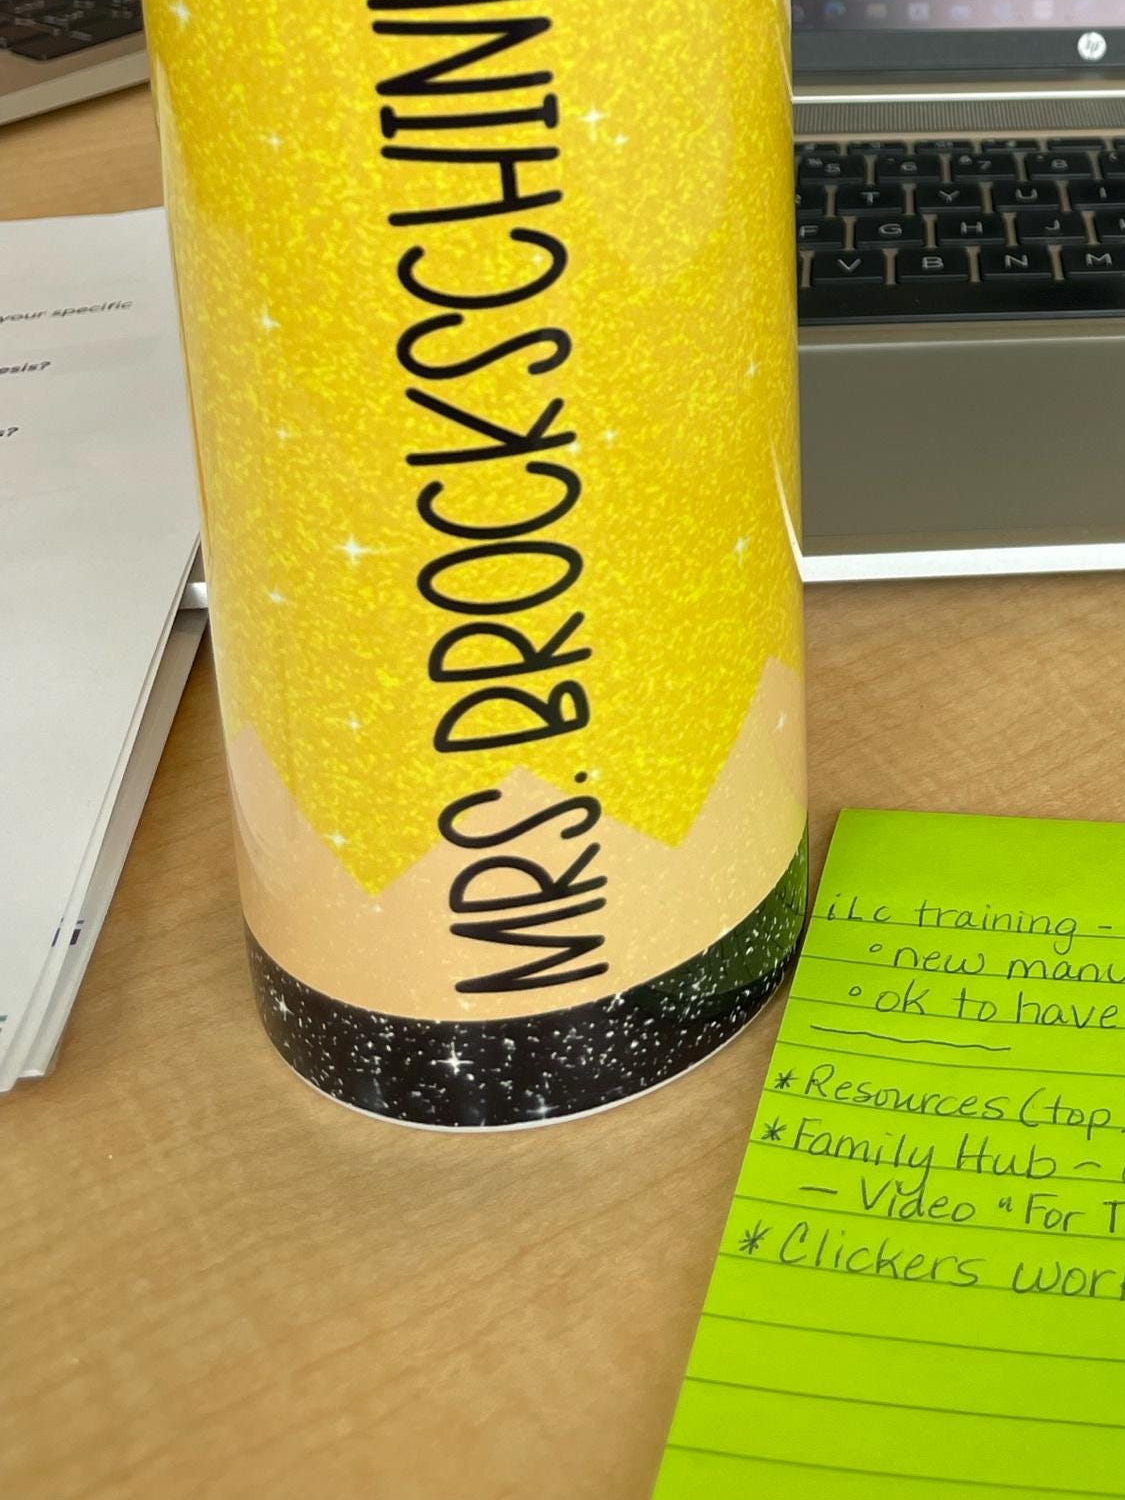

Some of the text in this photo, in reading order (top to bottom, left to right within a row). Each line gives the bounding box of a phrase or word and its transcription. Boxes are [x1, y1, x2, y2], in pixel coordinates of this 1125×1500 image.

[861, 191, 880, 204] T
[938, 190, 960, 202] Y
[1015, 188, 1038, 199] U
[878, 223, 902, 235] G
[960, 221, 983, 235] H
[1045, 219, 1061, 231] J
[837, 258, 861, 272] V
[921, 256, 944, 270] B
[1004, 254, 1029, 269] N
[1086, 253, 1112, 267] M
[52, 300, 133, 318] specific
[439, 771, 609, 994] MRS.
[914, 899, 1078, 956] training
[893, 946, 985, 975] new
[953, 987, 998, 1022] to
[1016, 991, 1119, 1029] have
[793, 1116, 935, 1196] Family
[957, 1132, 1057, 1180] Hub
[861, 1177, 976, 1222] Video
[780, 1221, 988, 1287] Clickers
